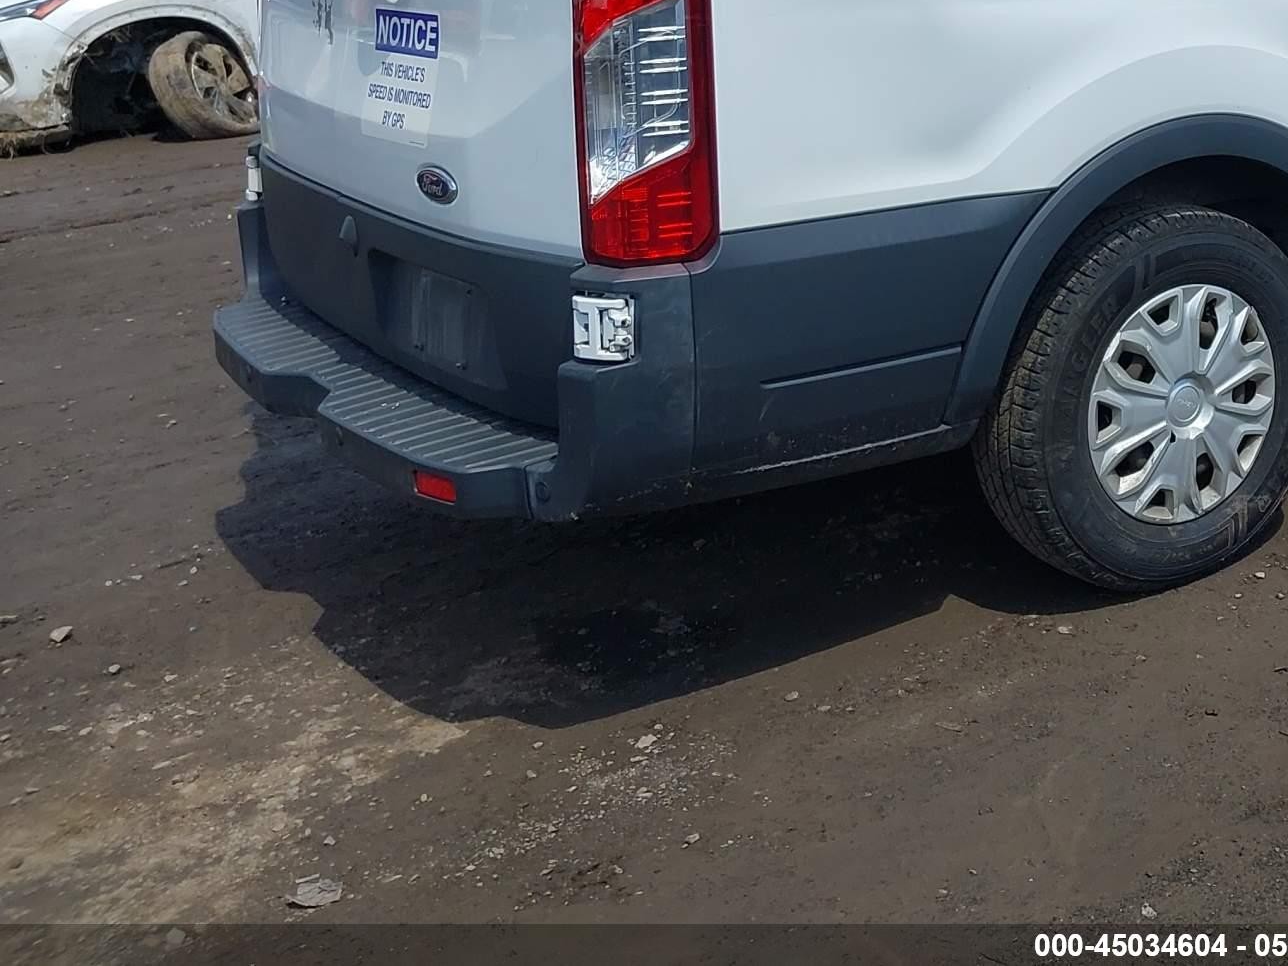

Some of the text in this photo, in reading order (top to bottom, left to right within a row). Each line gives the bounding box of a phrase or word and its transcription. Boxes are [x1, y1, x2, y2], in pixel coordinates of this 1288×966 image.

[377, 15, 437, 52] NOTICE
[380, 60, 426, 83] THIS VEHICLE'S
[367, 82, 431, 110] SPEED IS MONITORED
[382, 110, 406, 130] BY GPS
[421, 173, 444, 196] Ford
